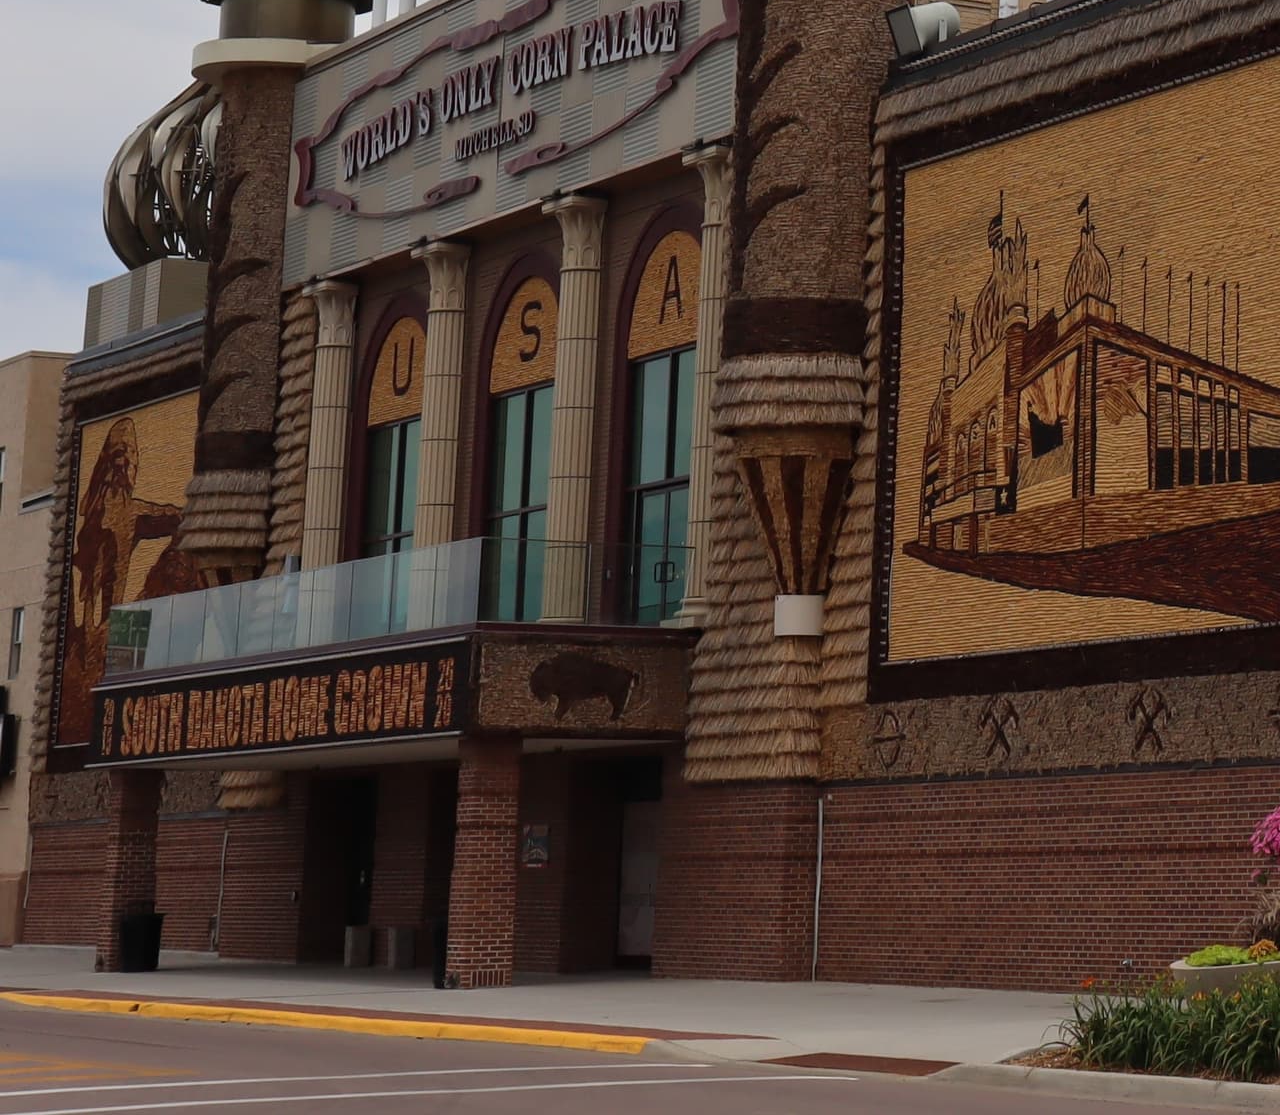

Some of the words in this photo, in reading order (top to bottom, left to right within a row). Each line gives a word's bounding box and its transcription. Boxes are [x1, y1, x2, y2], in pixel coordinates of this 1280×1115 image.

[339, 88, 433, 182] WORLD'S
[439, 54, 501, 124] ONLY
[507, 24, 575, 95] CORN
[577, 0, 683, 71] PALACE
[454, 122, 517, 162] MITCHELL,
[517, 109, 537, 136] SD
[392, 335, 415, 397] U
[518, 300, 543, 363] S
[658, 254, 684, 325] A
[121, 691, 183, 756] SOUTH
[186, 681, 265, 749] DAKOTA
[267, 674, 331, 741] HOME
[334, 661, 428, 734] GROWN
